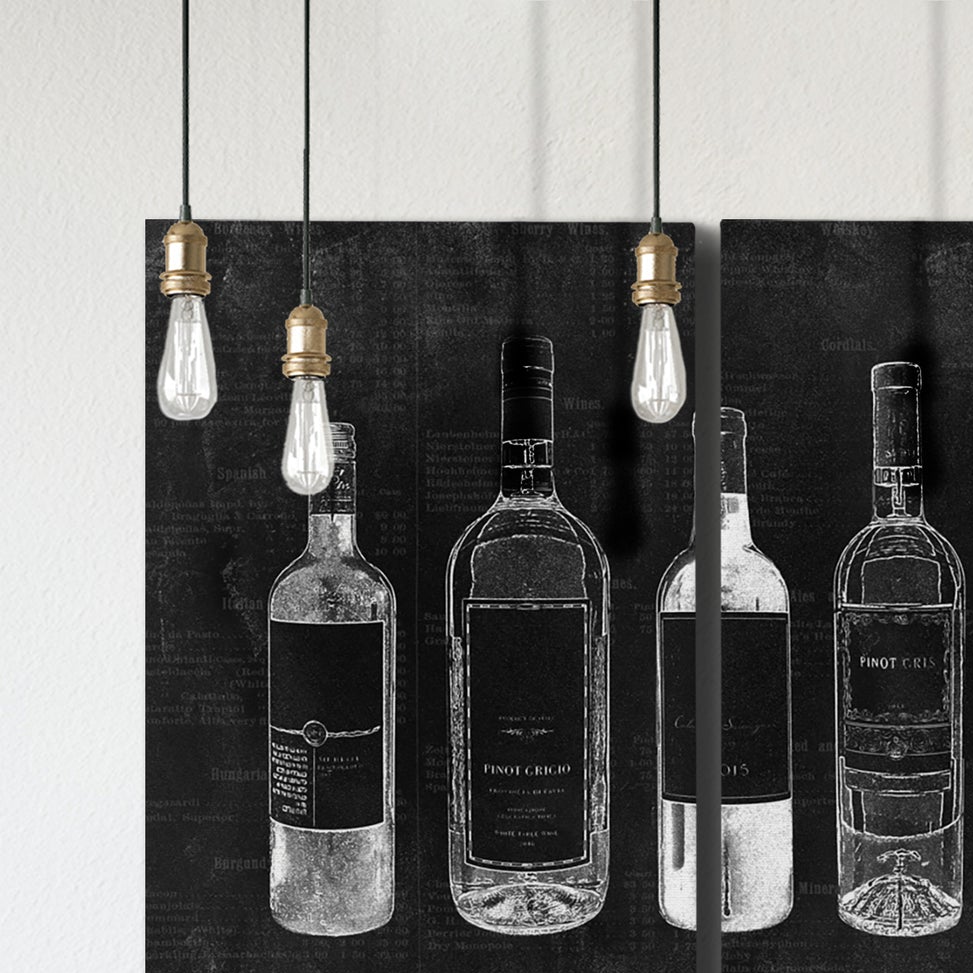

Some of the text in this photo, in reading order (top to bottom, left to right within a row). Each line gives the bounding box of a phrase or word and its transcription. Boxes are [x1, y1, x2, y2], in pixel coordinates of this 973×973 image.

[859, 656, 936, 670] PINOT GRIS
[483, 763, 572, 777] PINOT GRIGIO
